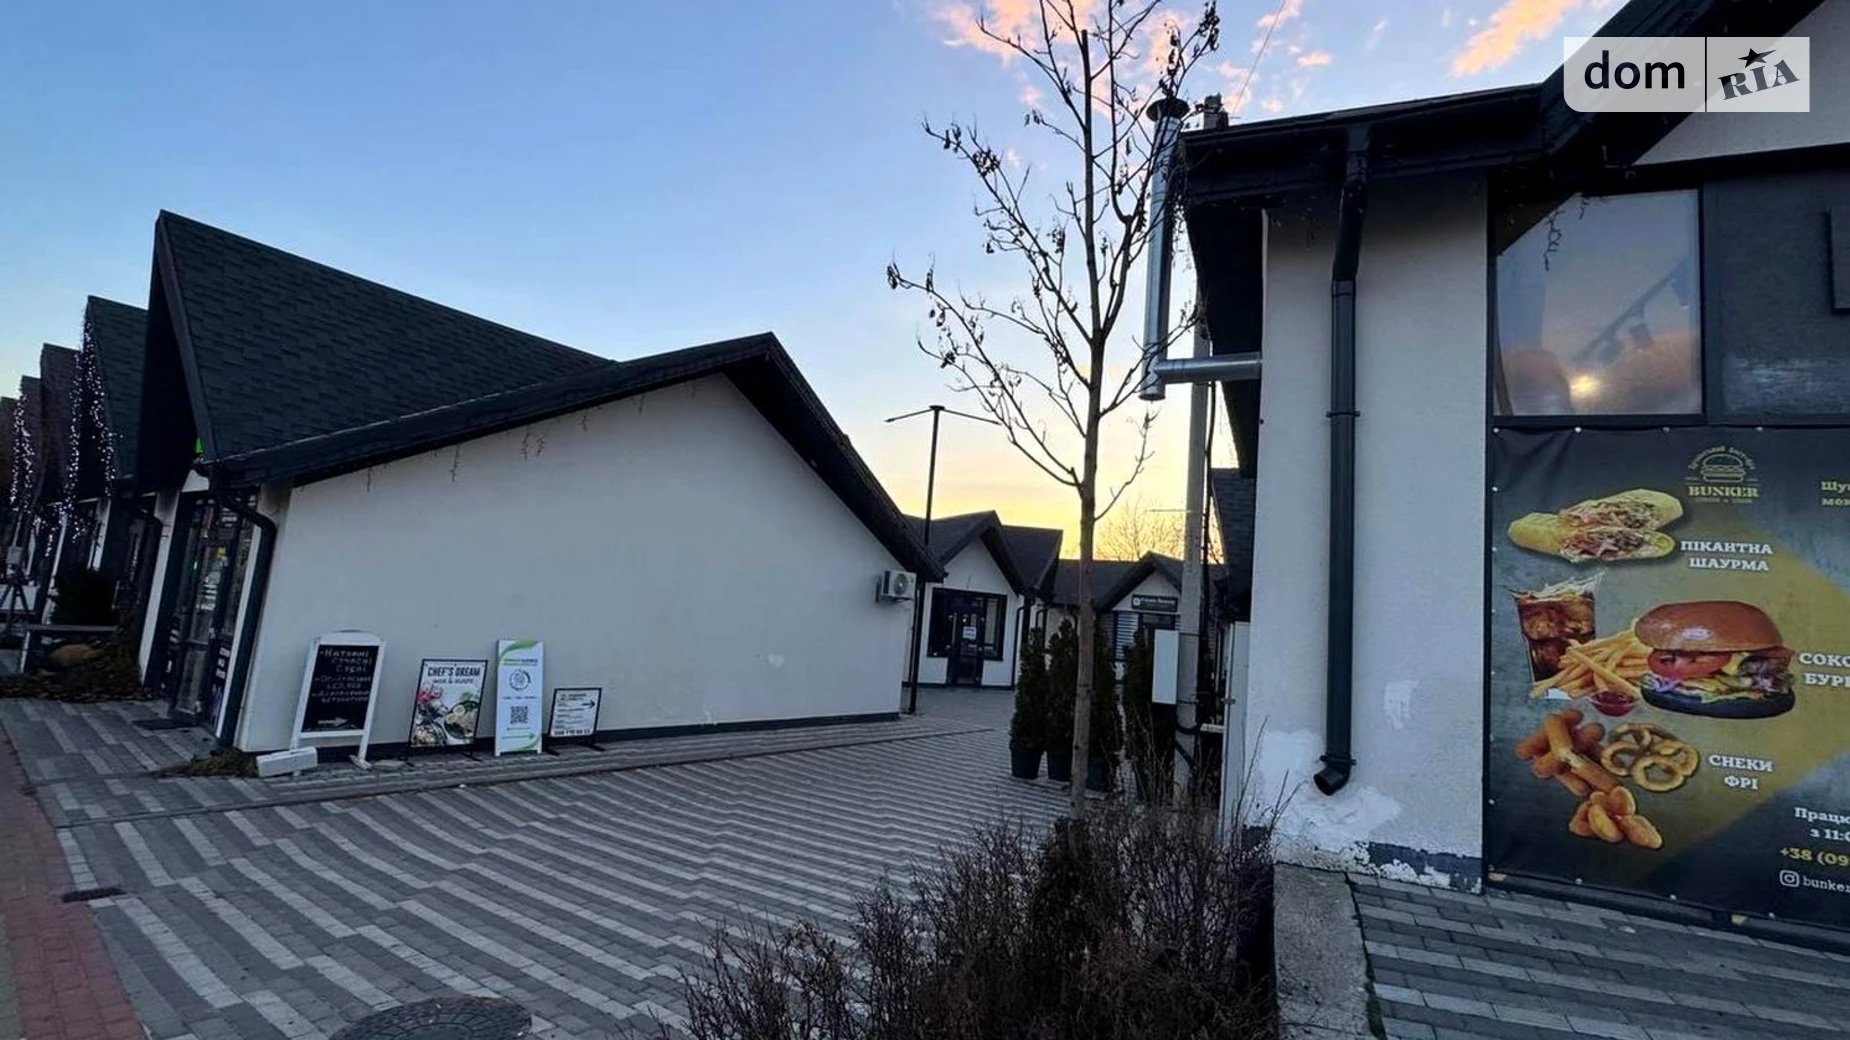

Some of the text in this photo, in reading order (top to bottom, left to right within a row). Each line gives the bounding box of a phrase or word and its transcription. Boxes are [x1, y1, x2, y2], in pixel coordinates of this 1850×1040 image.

[1688, 486, 1759, 498] BUNKER
[1680, 540, 1774, 555] ПІКАНТНА
[1689, 557, 1769, 571] ШАУРМА
[427, 666, 481, 677] CHEF'S DREAM
[1708, 754, 1774, 772] СНЕКИ
[1724, 775, 1758, 790] ФРІ
[1780, 847, 1813, 861] +38
